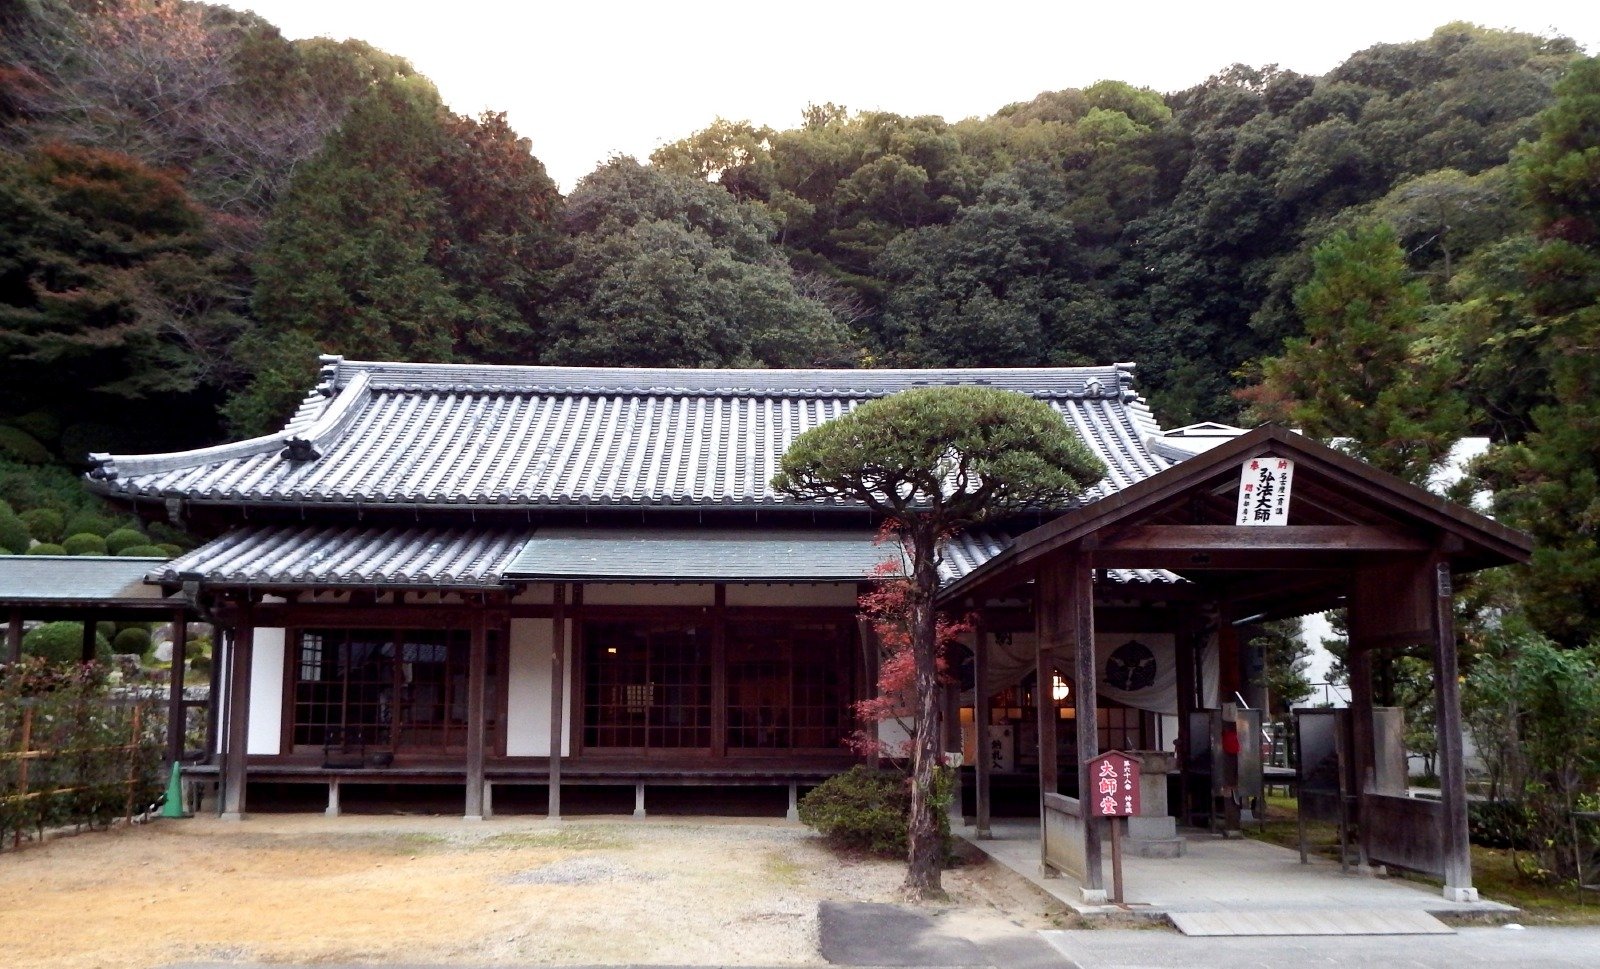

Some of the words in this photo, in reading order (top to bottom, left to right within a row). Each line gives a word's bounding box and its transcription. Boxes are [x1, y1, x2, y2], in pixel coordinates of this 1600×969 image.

[1254, 467, 1275, 522] 弘法大師
[1099, 760, 1118, 814] 大師堂
